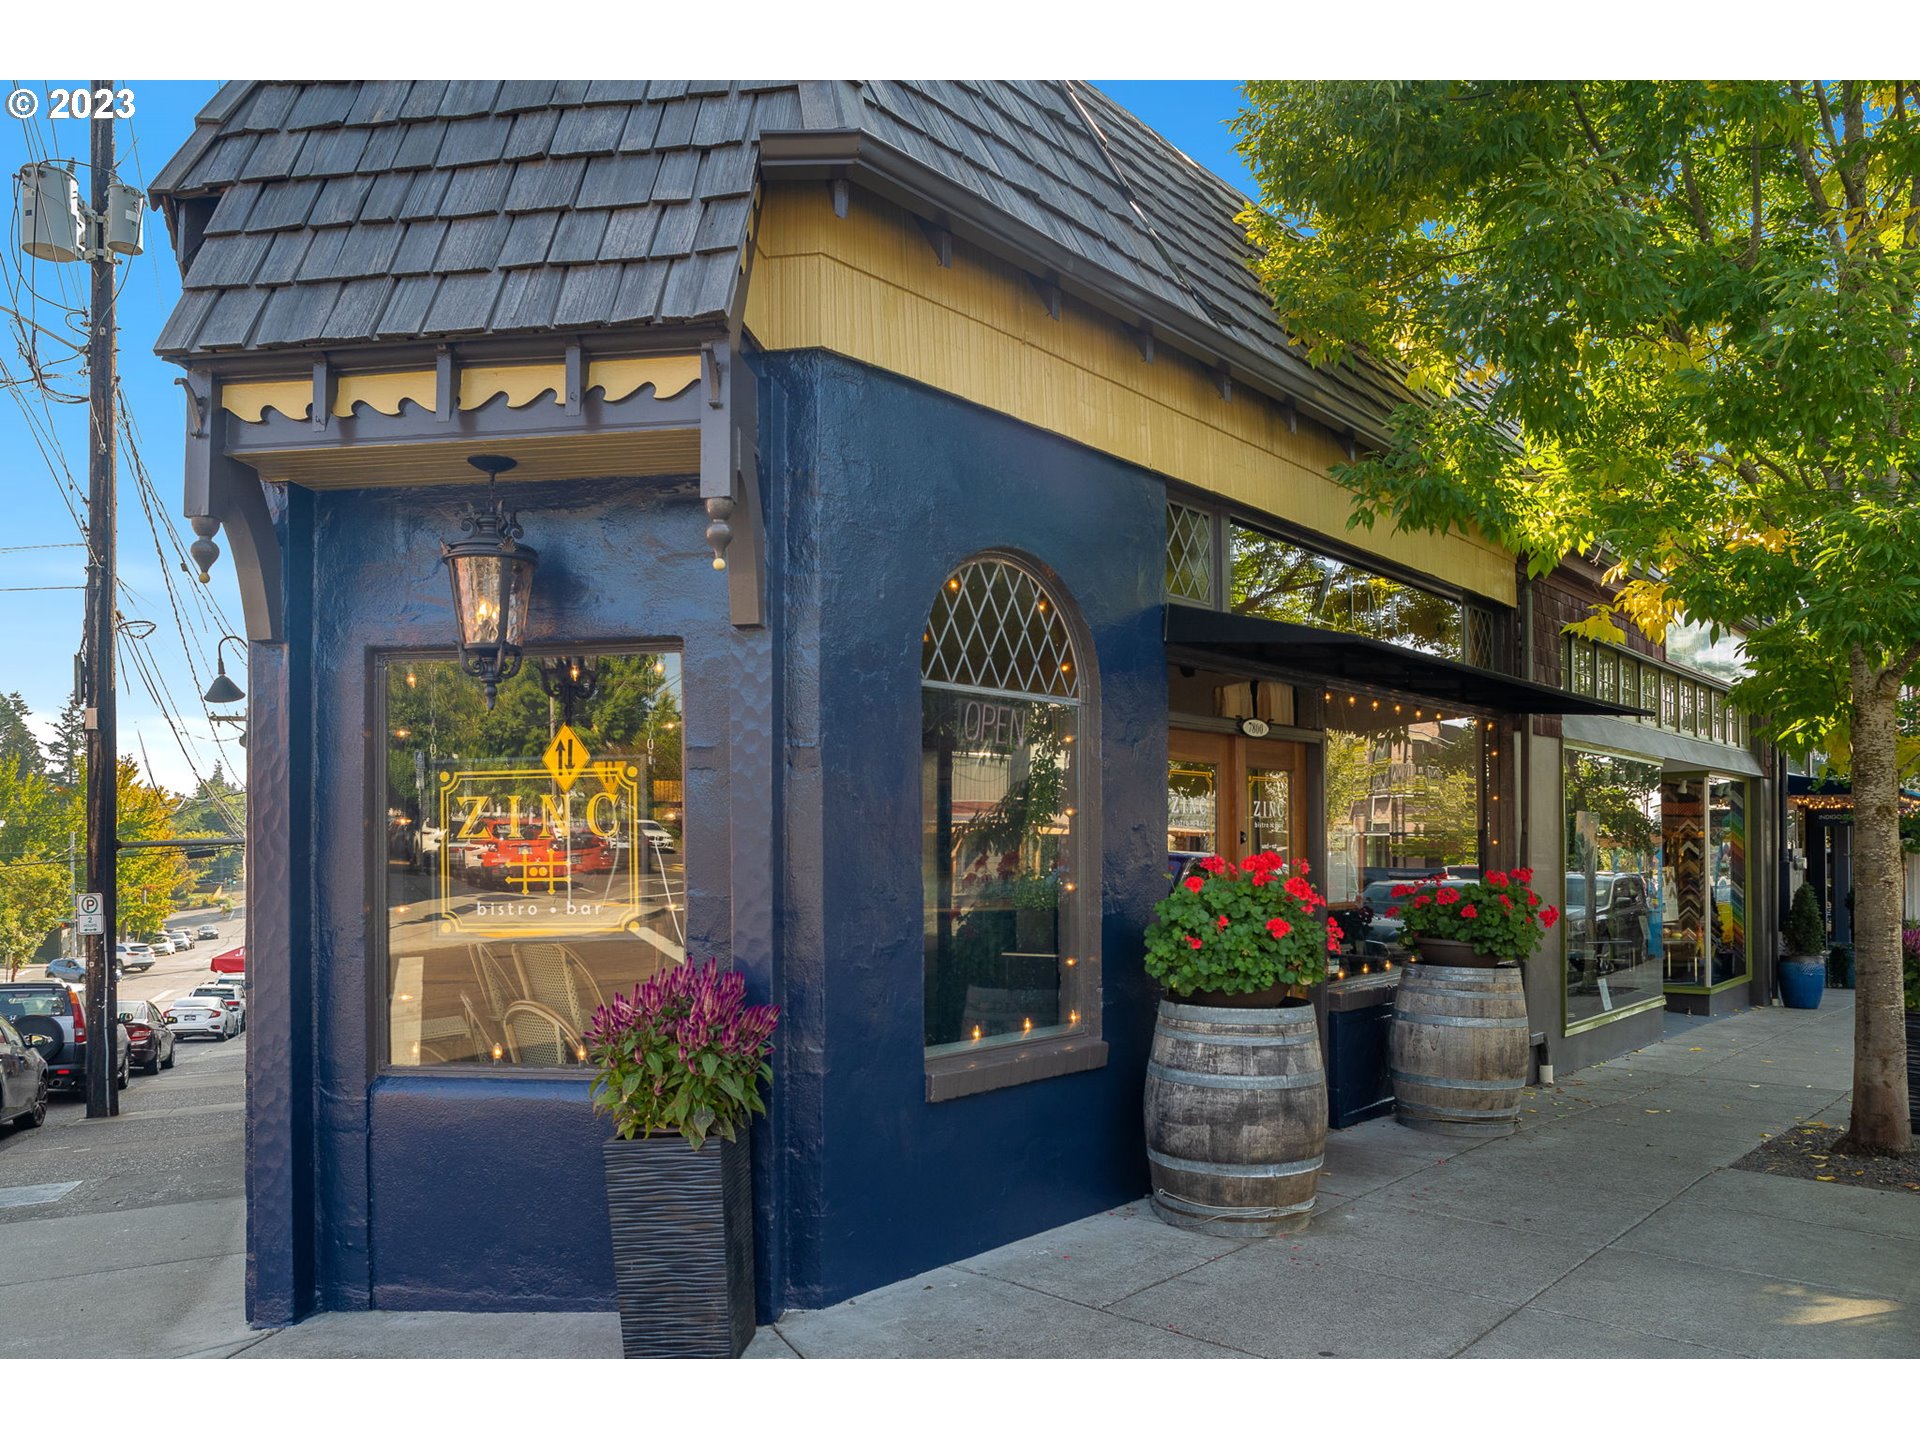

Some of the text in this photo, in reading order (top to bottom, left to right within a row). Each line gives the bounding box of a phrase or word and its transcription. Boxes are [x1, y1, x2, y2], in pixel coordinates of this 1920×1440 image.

[965, 701, 1025, 747] OPEN
[1171, 796, 1207, 815] ZINC
[1253, 800, 1285, 818] ZINC
[456, 791, 621, 840] ZINC
[86, 899, 94, 911] P
[477, 901, 538, 916] bistro
[566, 900, 602, 916] bar
